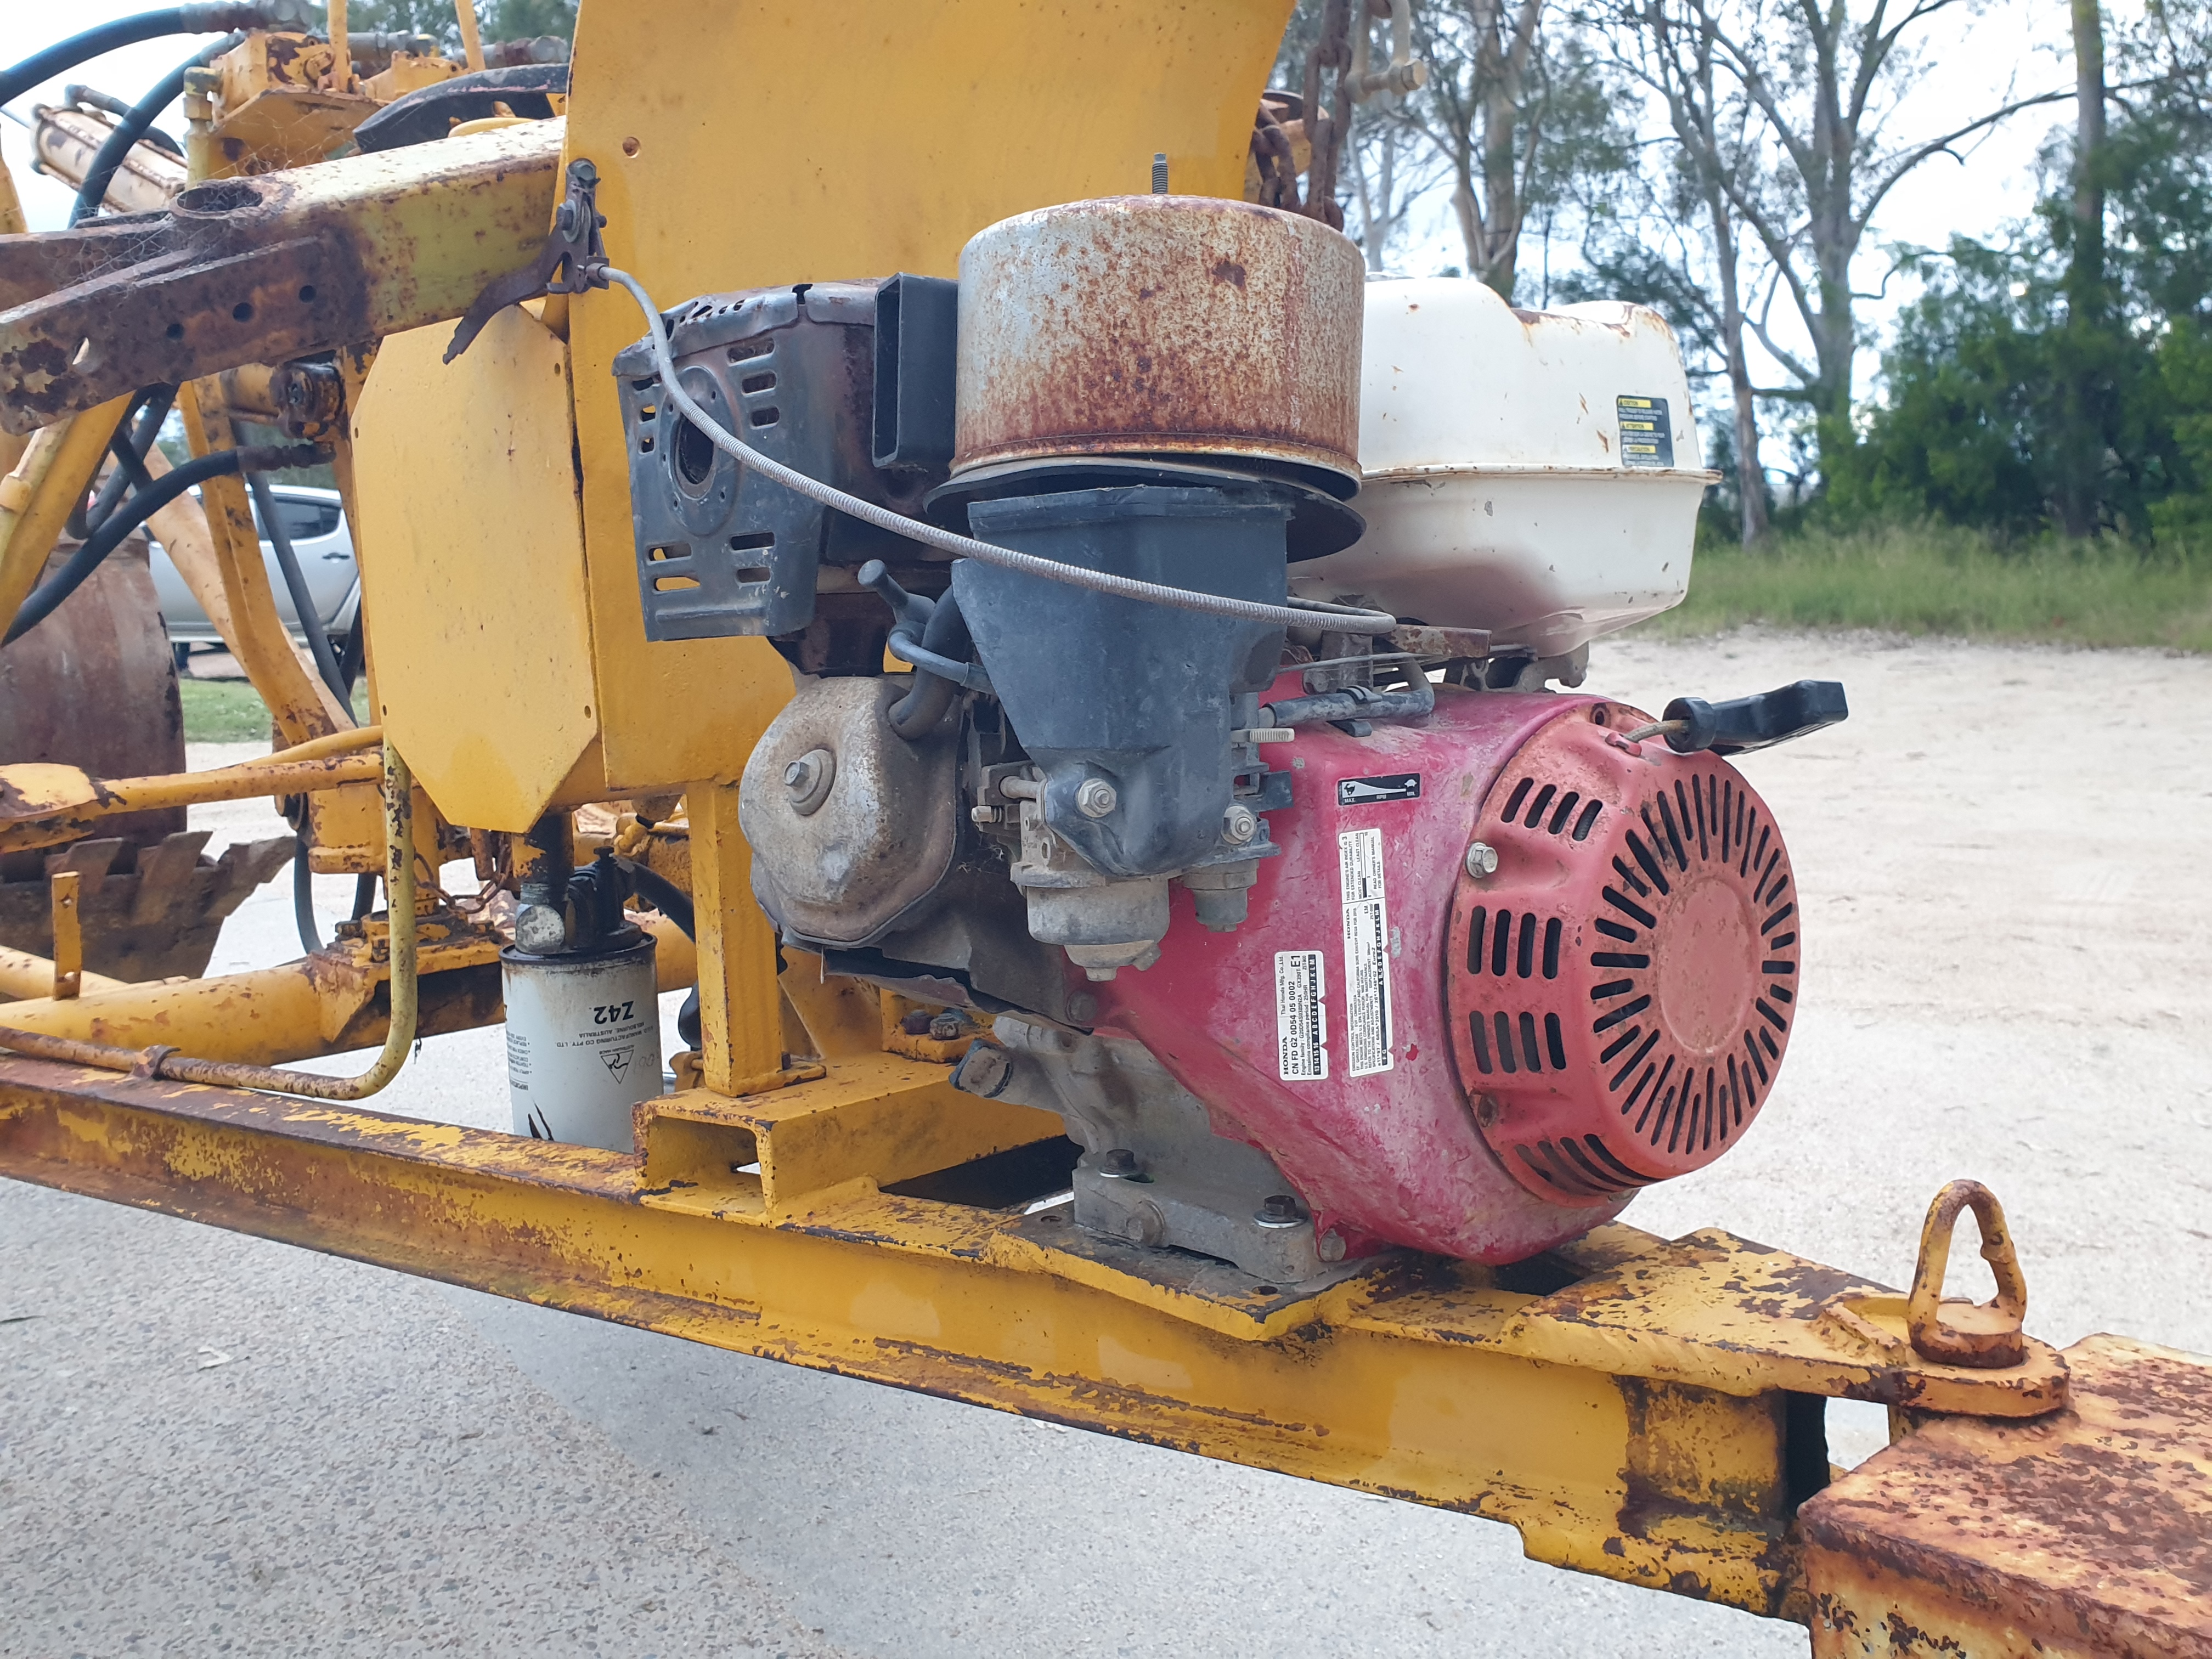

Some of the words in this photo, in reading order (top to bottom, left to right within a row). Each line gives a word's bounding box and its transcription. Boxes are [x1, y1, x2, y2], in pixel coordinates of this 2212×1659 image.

[1290, 955, 1300, 967] E1
[594, 1001, 634, 1024] Z42
[1289, 1003, 1296, 1012] 05
[579, 1030, 613, 1038] AUSTRALIA
[596, 1030, 642, 1043] MANUFACTURING
[1290, 1037, 1297, 1047] G2
[1291, 1050, 1298, 1060] FD
[1291, 1063, 1299, 1074] CN
